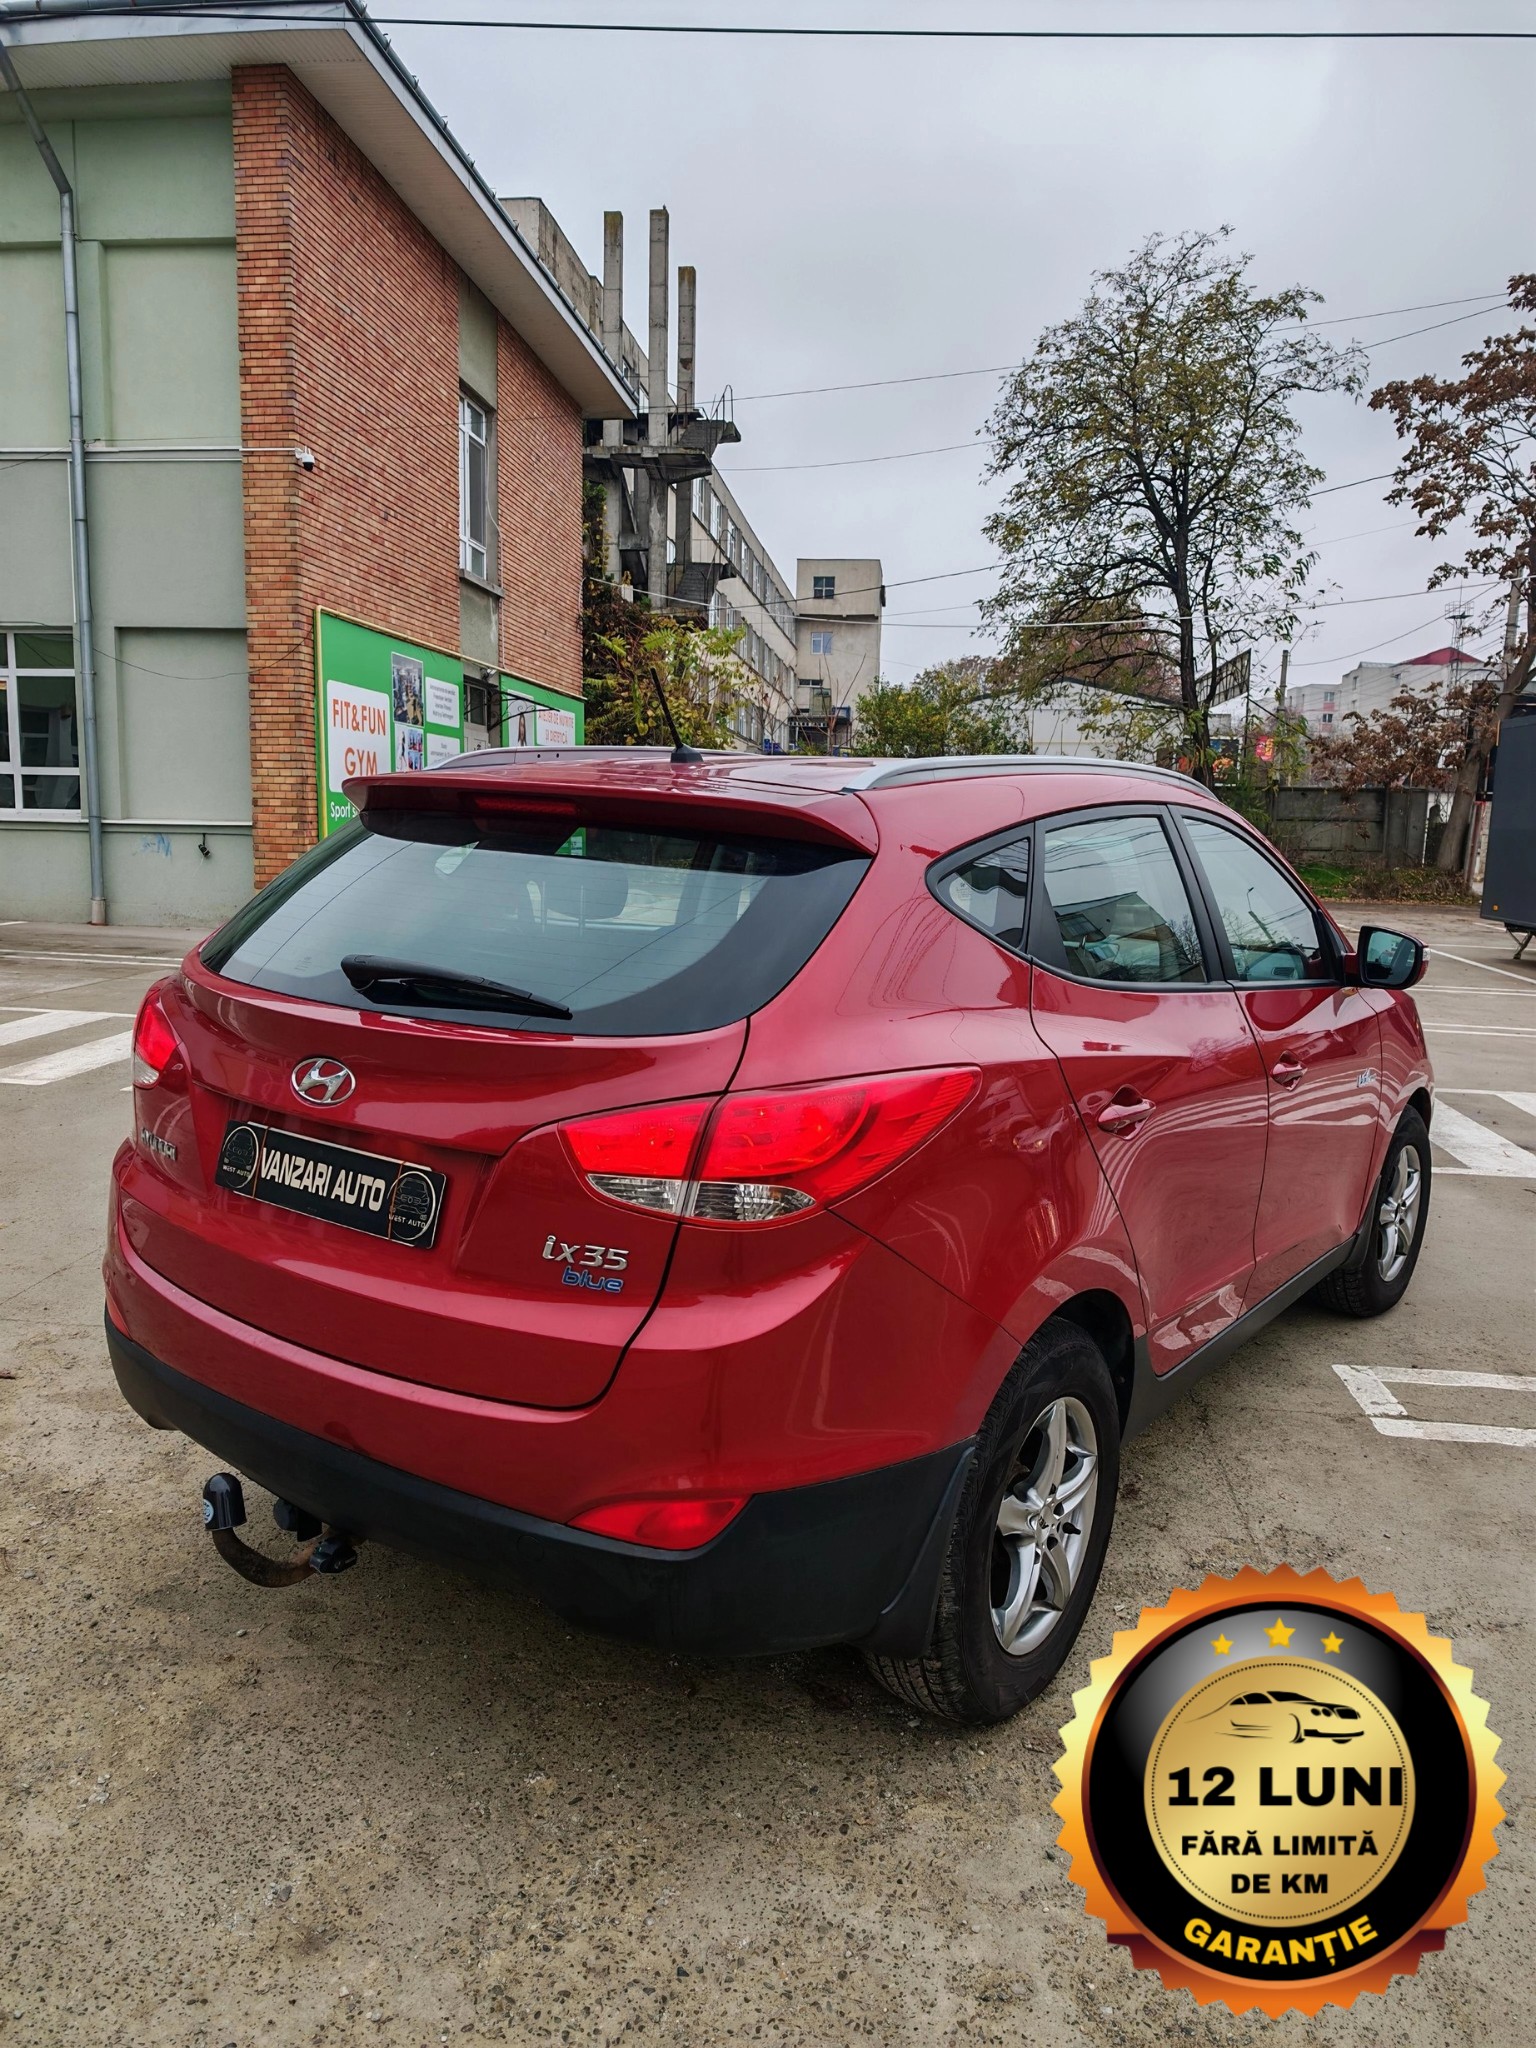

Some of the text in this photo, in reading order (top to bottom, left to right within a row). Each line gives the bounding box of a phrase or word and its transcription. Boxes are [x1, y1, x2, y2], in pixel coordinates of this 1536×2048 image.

[332, 698, 386, 736] FIT&FUN
[344, 747, 378, 776] GYM
[330, 801, 351, 822] Sport
[261, 1147, 386, 1212] VANZARI AUTO
[407, 1219, 426, 1229] AUTO
[561, 1265, 624, 1293] blue
